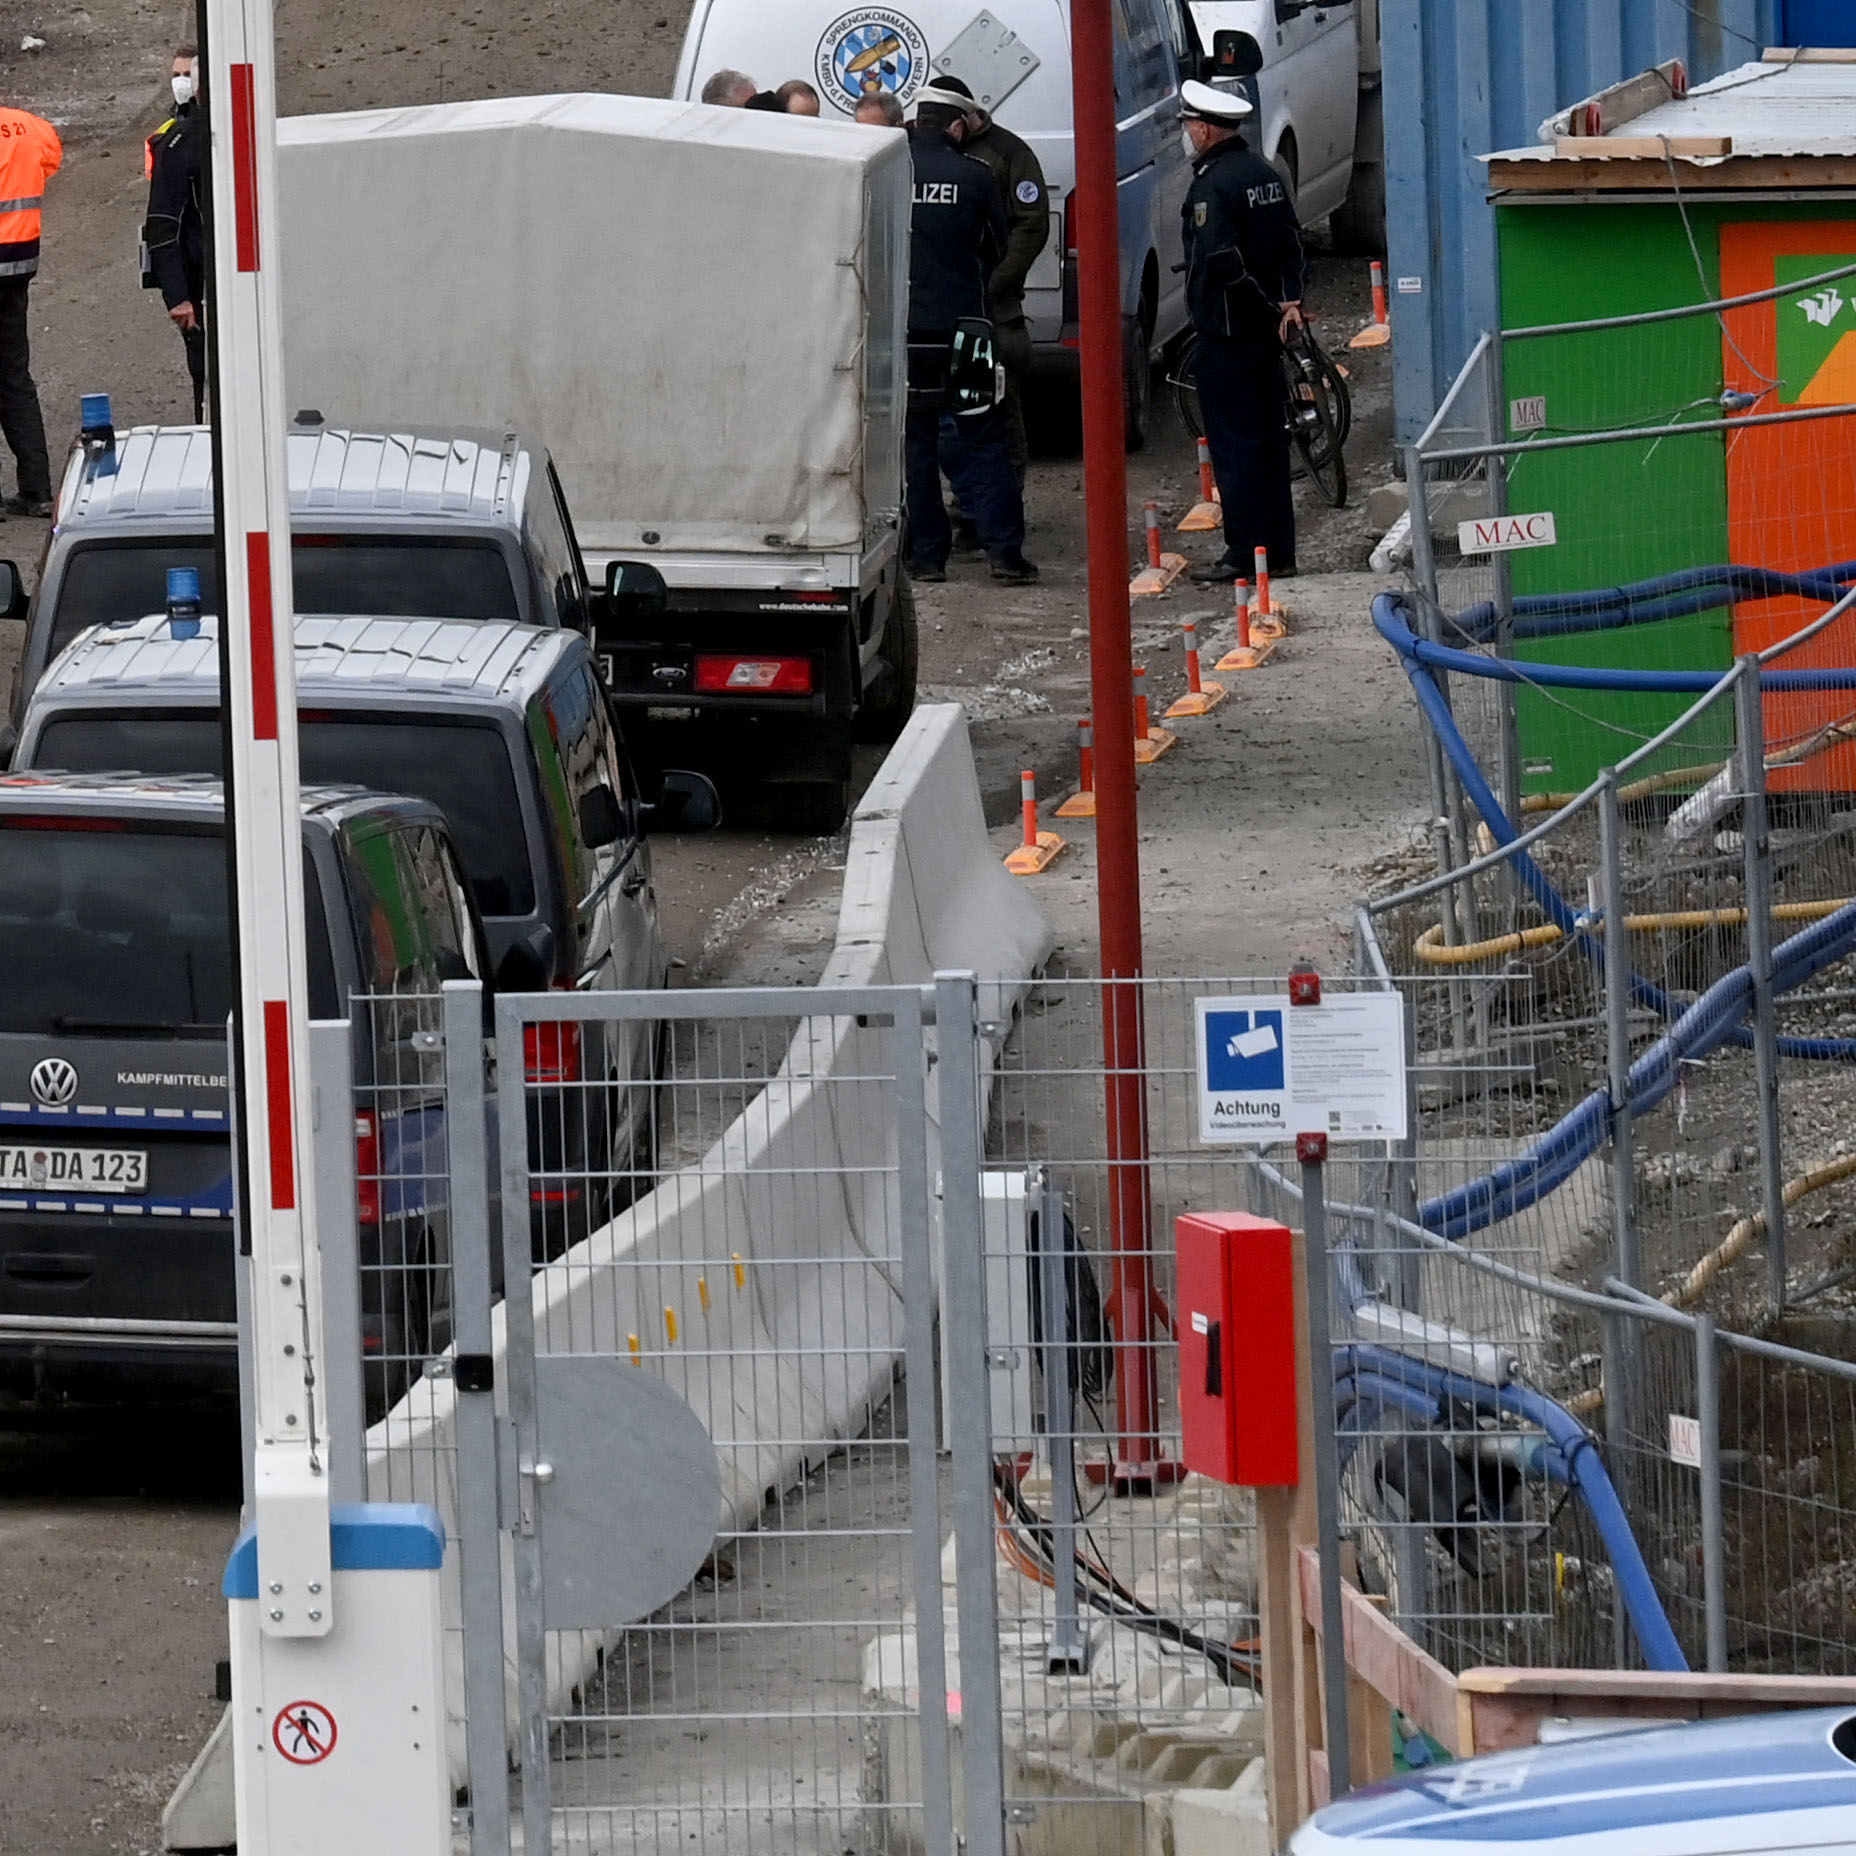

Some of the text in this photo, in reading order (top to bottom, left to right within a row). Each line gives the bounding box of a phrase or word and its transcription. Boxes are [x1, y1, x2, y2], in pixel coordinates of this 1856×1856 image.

[825, 10, 922, 50] SPRENGKOMMANDO
[901, 56, 924, 101] BAYERN
[1, 124, 11, 139] S
[913, 183, 959, 205] LIZEI
[1516, 398, 1544, 425] MAC
[1475, 515, 1547, 547] MAC
[116, 1072, 229, 1088] KAMPFMITTELBE
[1214, 1100, 1282, 1119] Achtung
[50, 1151, 83, 1181] DA
[91, 1152, 143, 1183] 123
